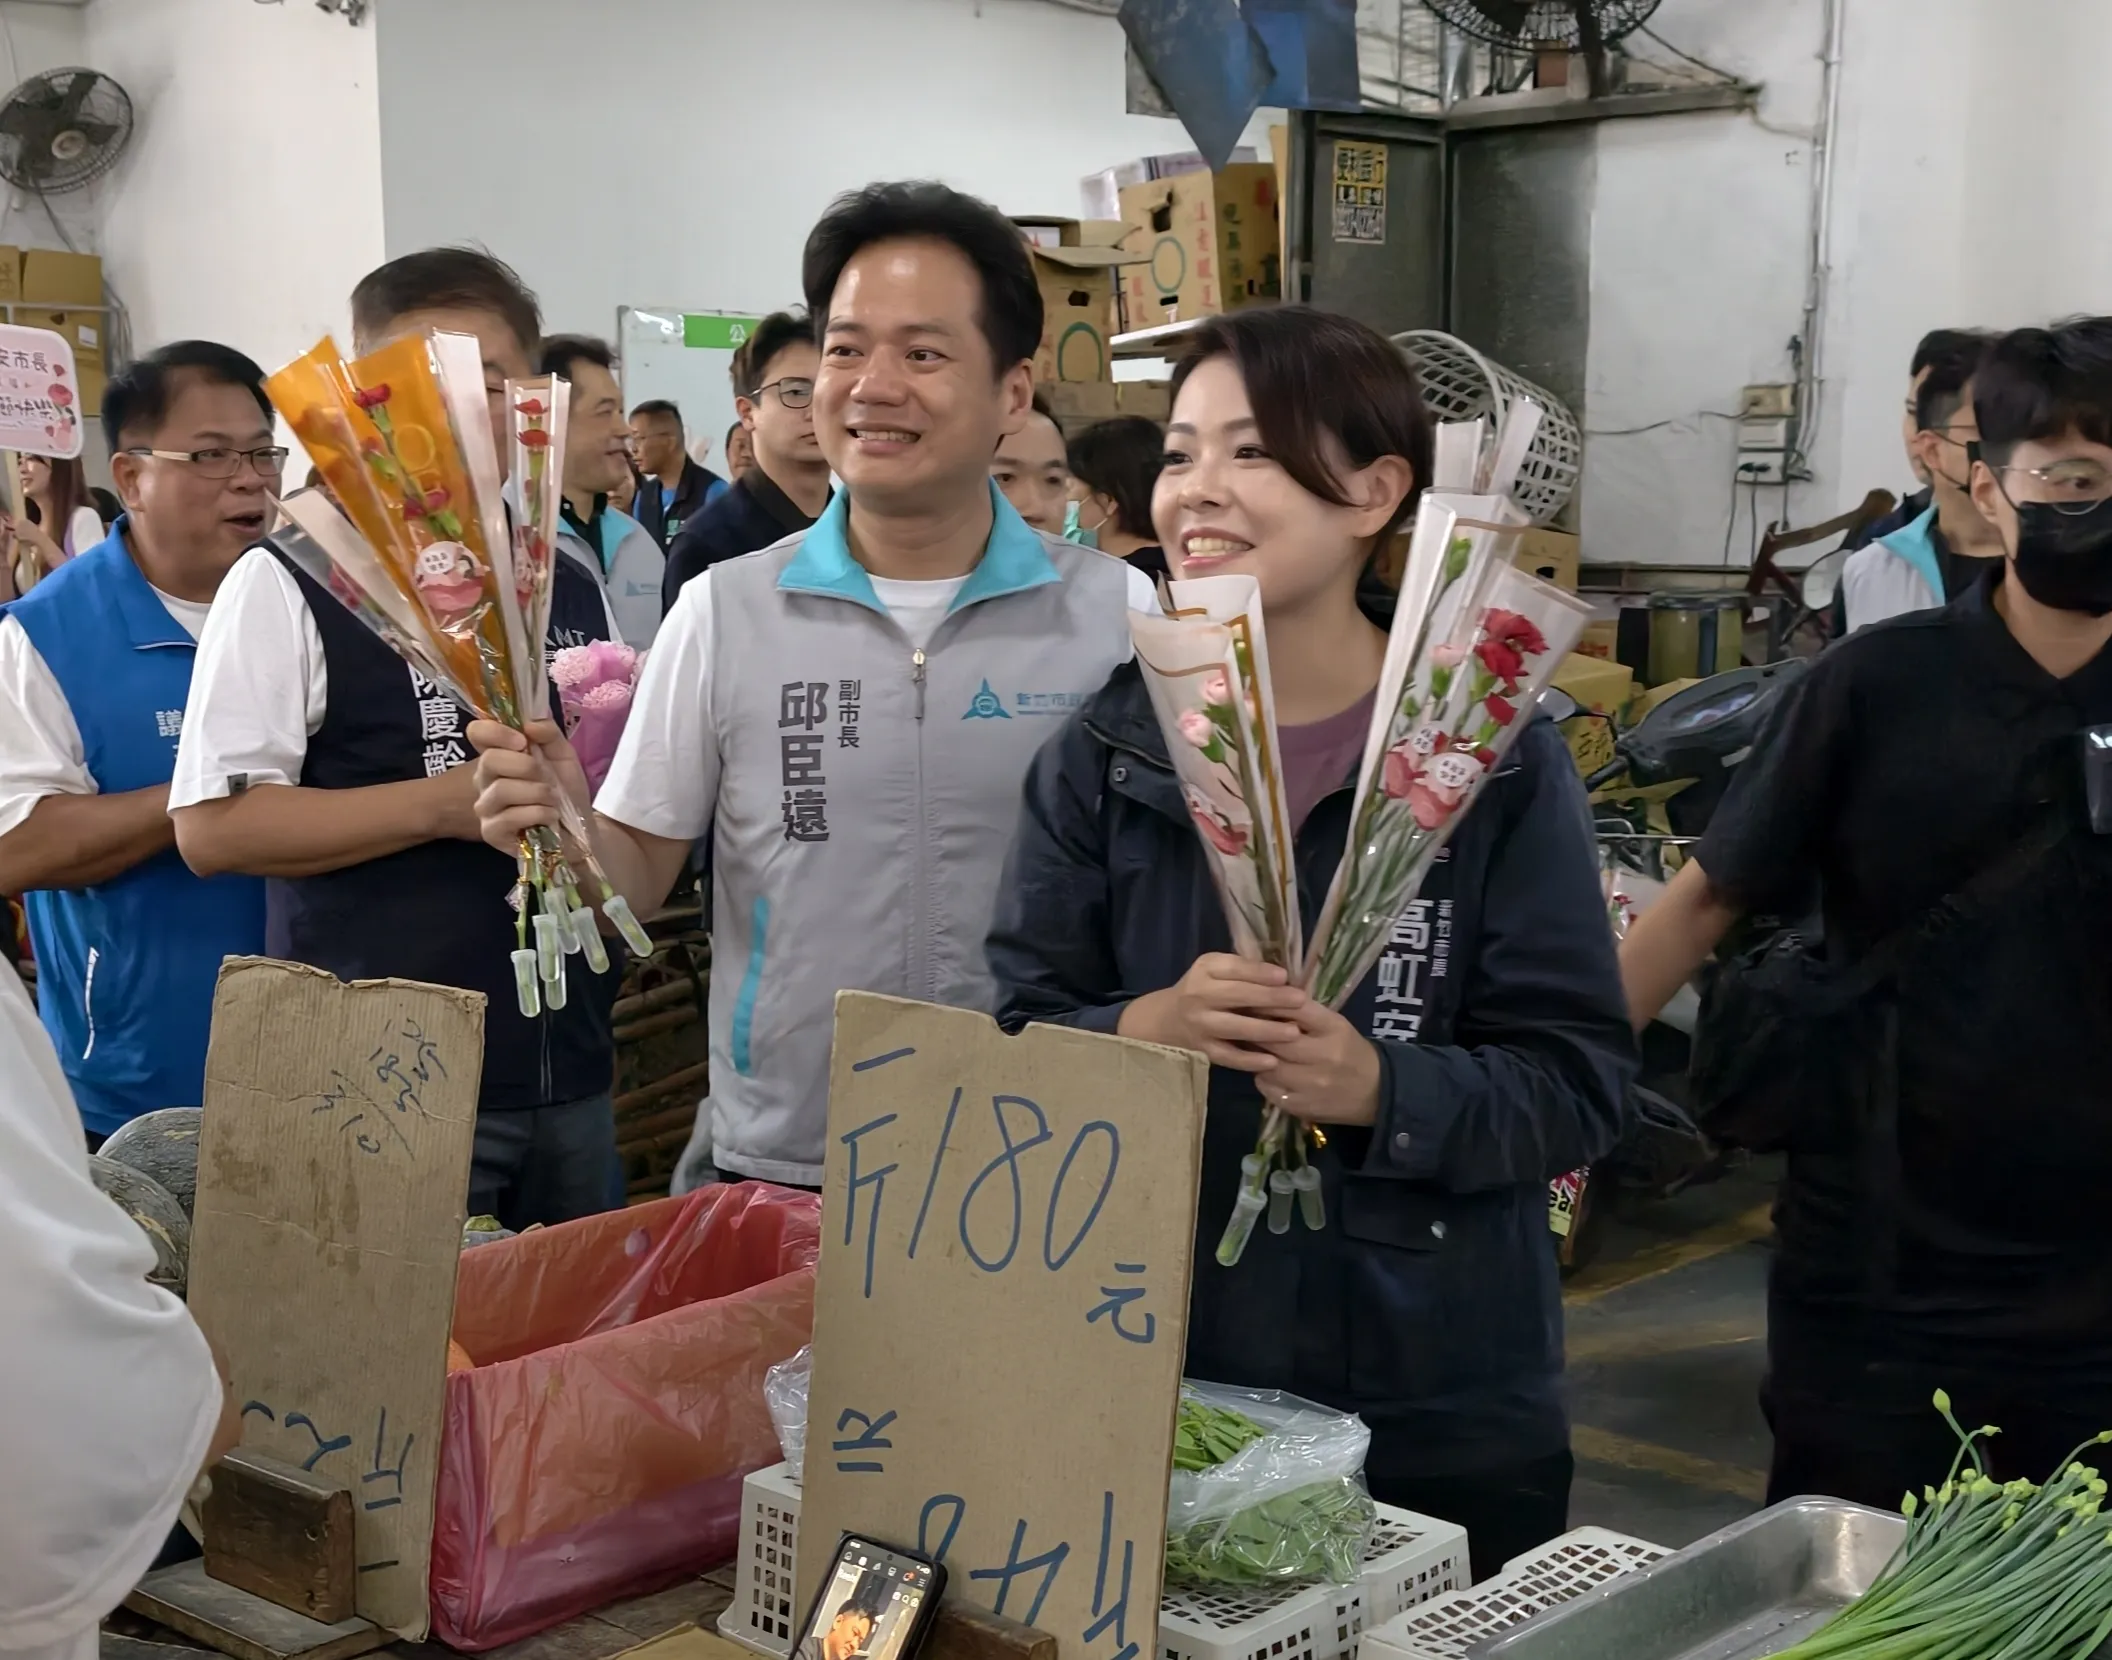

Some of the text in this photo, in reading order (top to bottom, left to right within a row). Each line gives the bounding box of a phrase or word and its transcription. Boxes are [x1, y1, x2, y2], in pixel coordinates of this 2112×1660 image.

[778, 681, 829, 842] 邱臣遠
[837, 679, 861, 748] 副市長
[907, 1087, 1120, 1274] 180
[1086, 1263, 1155, 1344] 元
